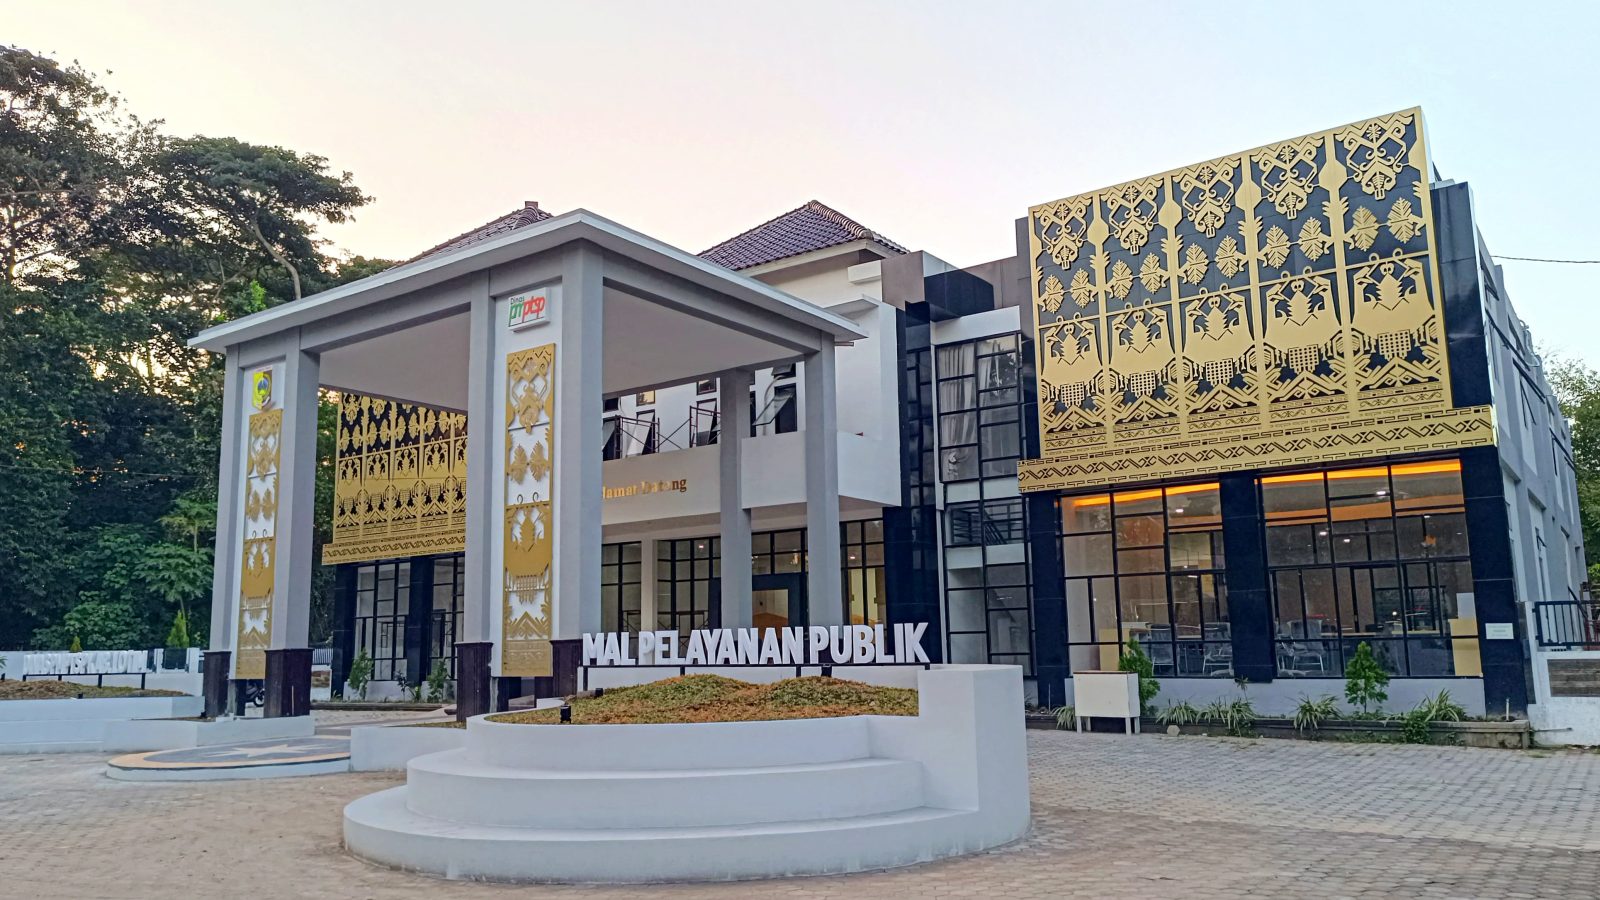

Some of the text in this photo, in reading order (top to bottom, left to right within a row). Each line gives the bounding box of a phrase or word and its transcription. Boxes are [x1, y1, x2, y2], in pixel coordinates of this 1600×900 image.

[602, 479, 687, 500] lamat Datang
[582, 622, 931, 666] MAL PELAYANAN PUBLIK
